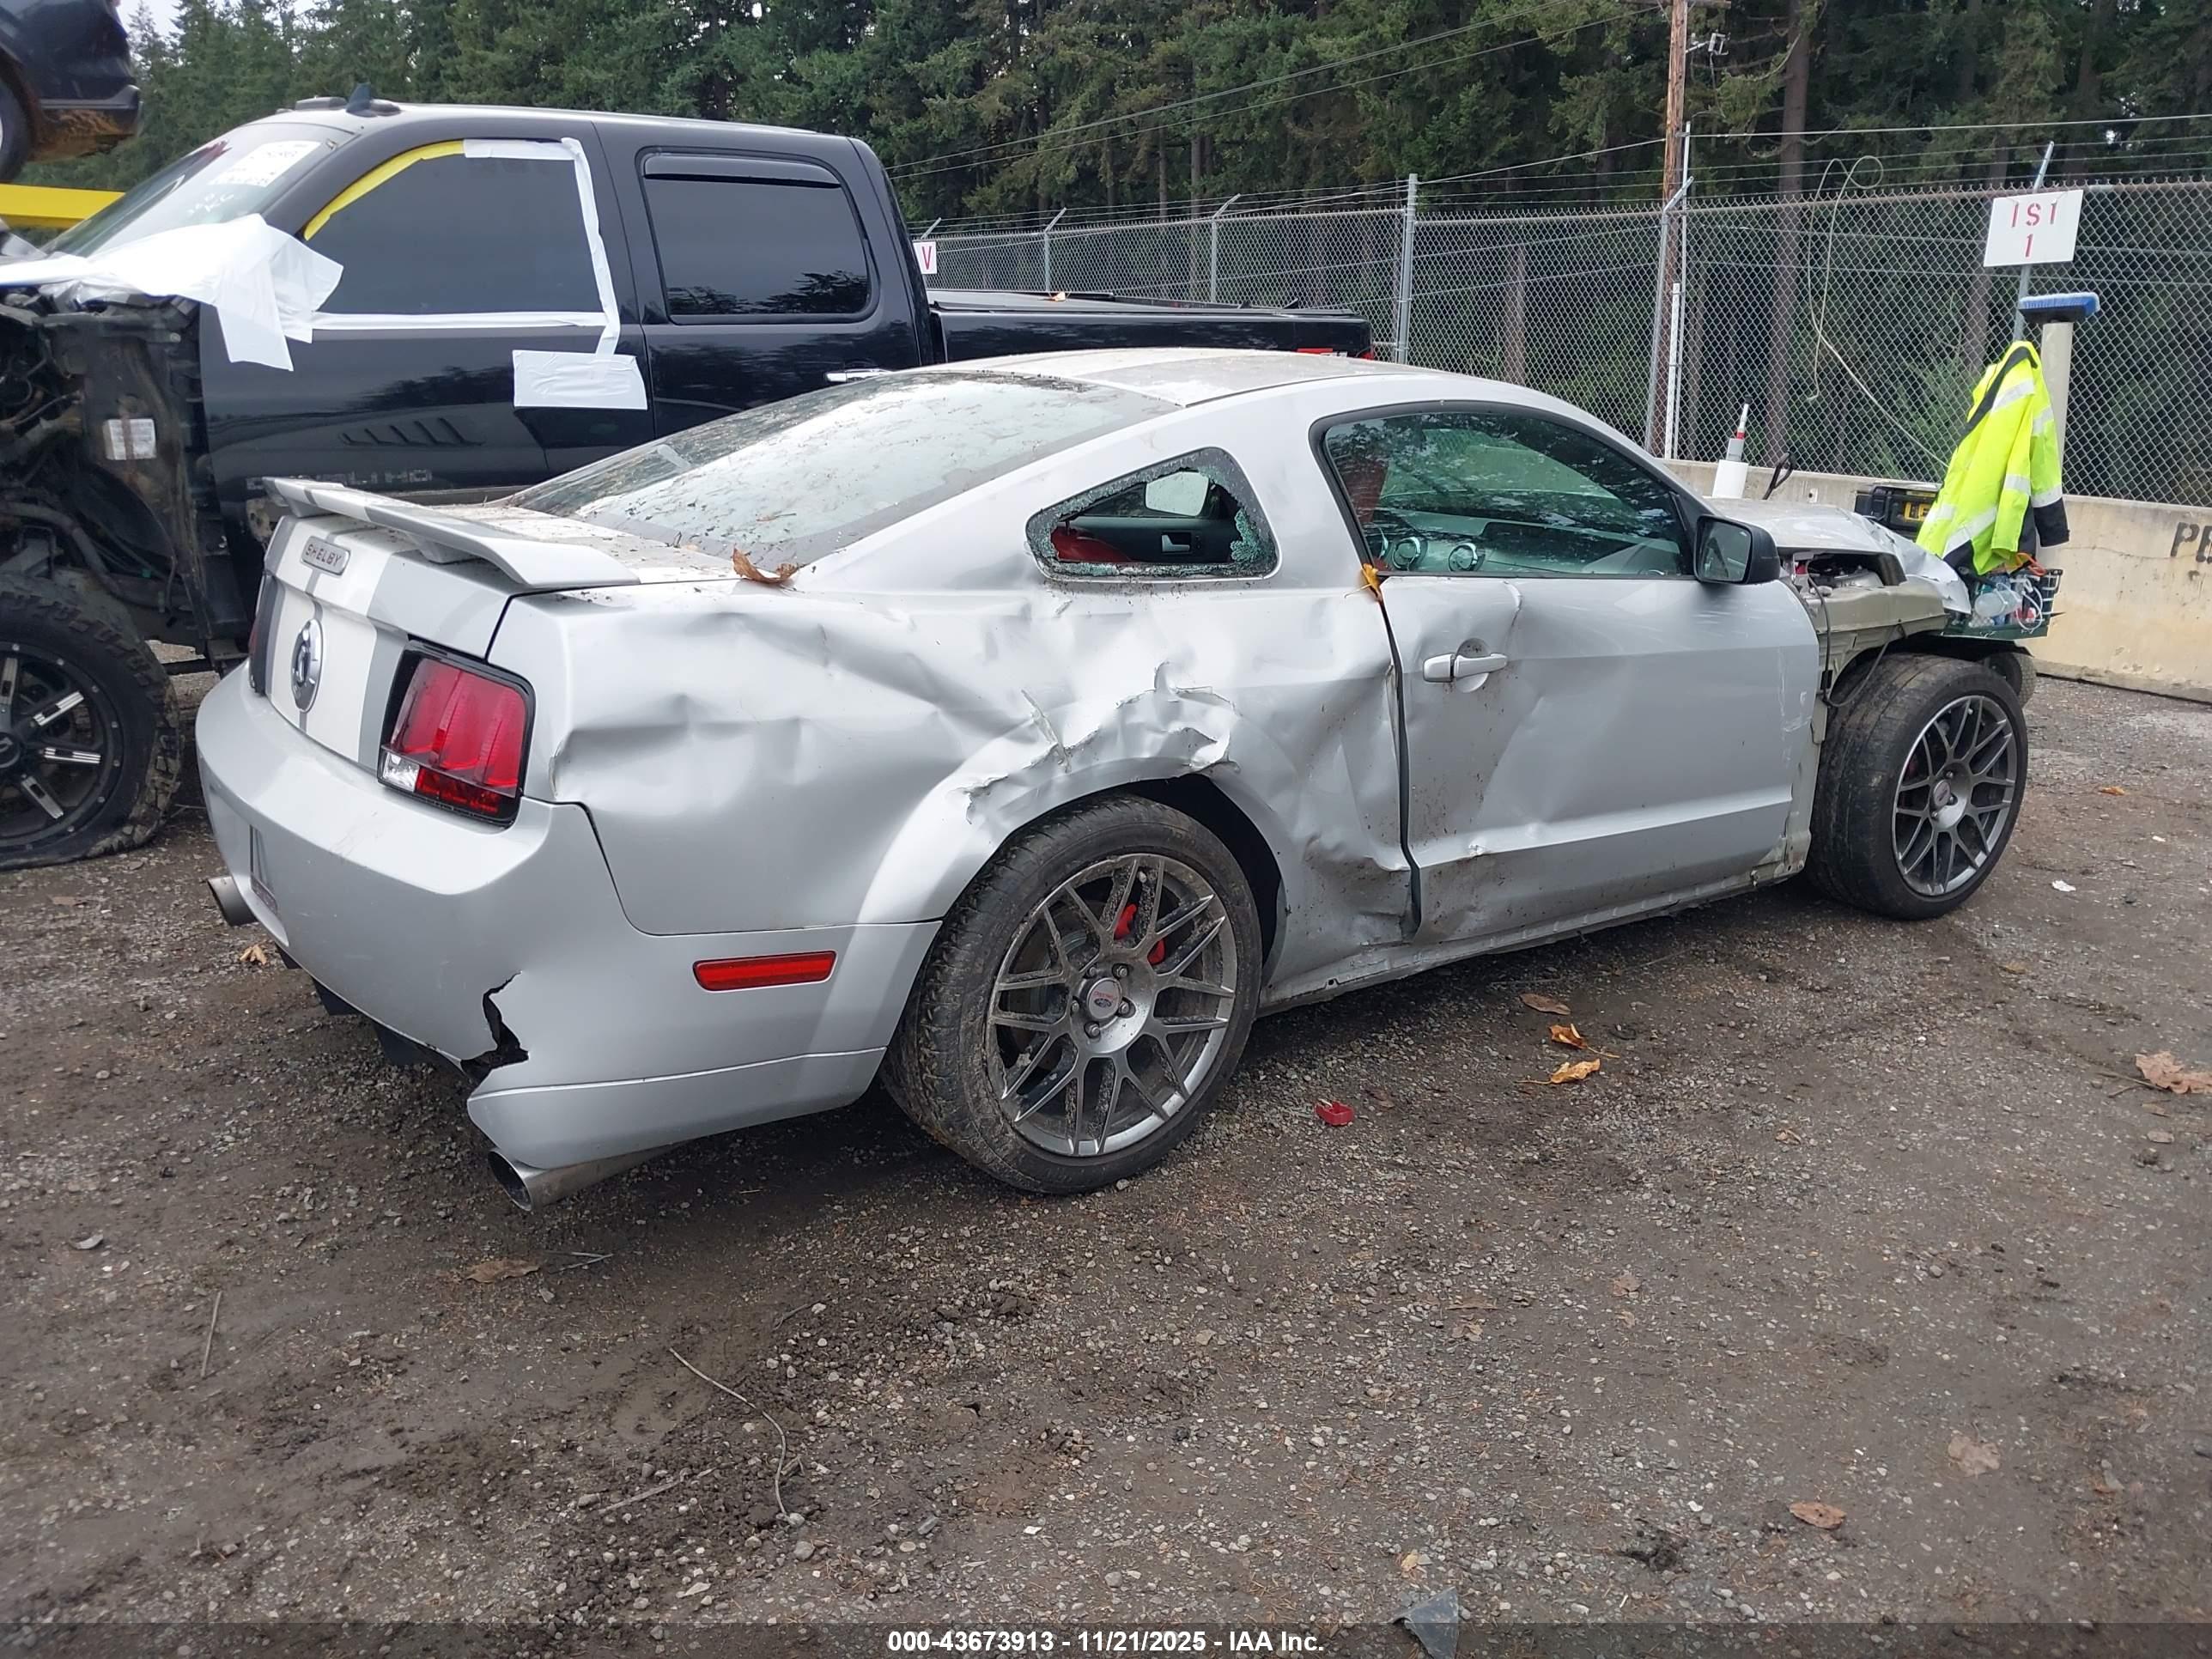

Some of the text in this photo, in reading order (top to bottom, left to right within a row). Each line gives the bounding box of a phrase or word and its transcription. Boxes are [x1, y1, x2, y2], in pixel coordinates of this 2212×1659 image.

[921, 246, 933, 270] V
[2024, 234, 2034, 258] 1
[305, 543, 342, 567] SHELBY
